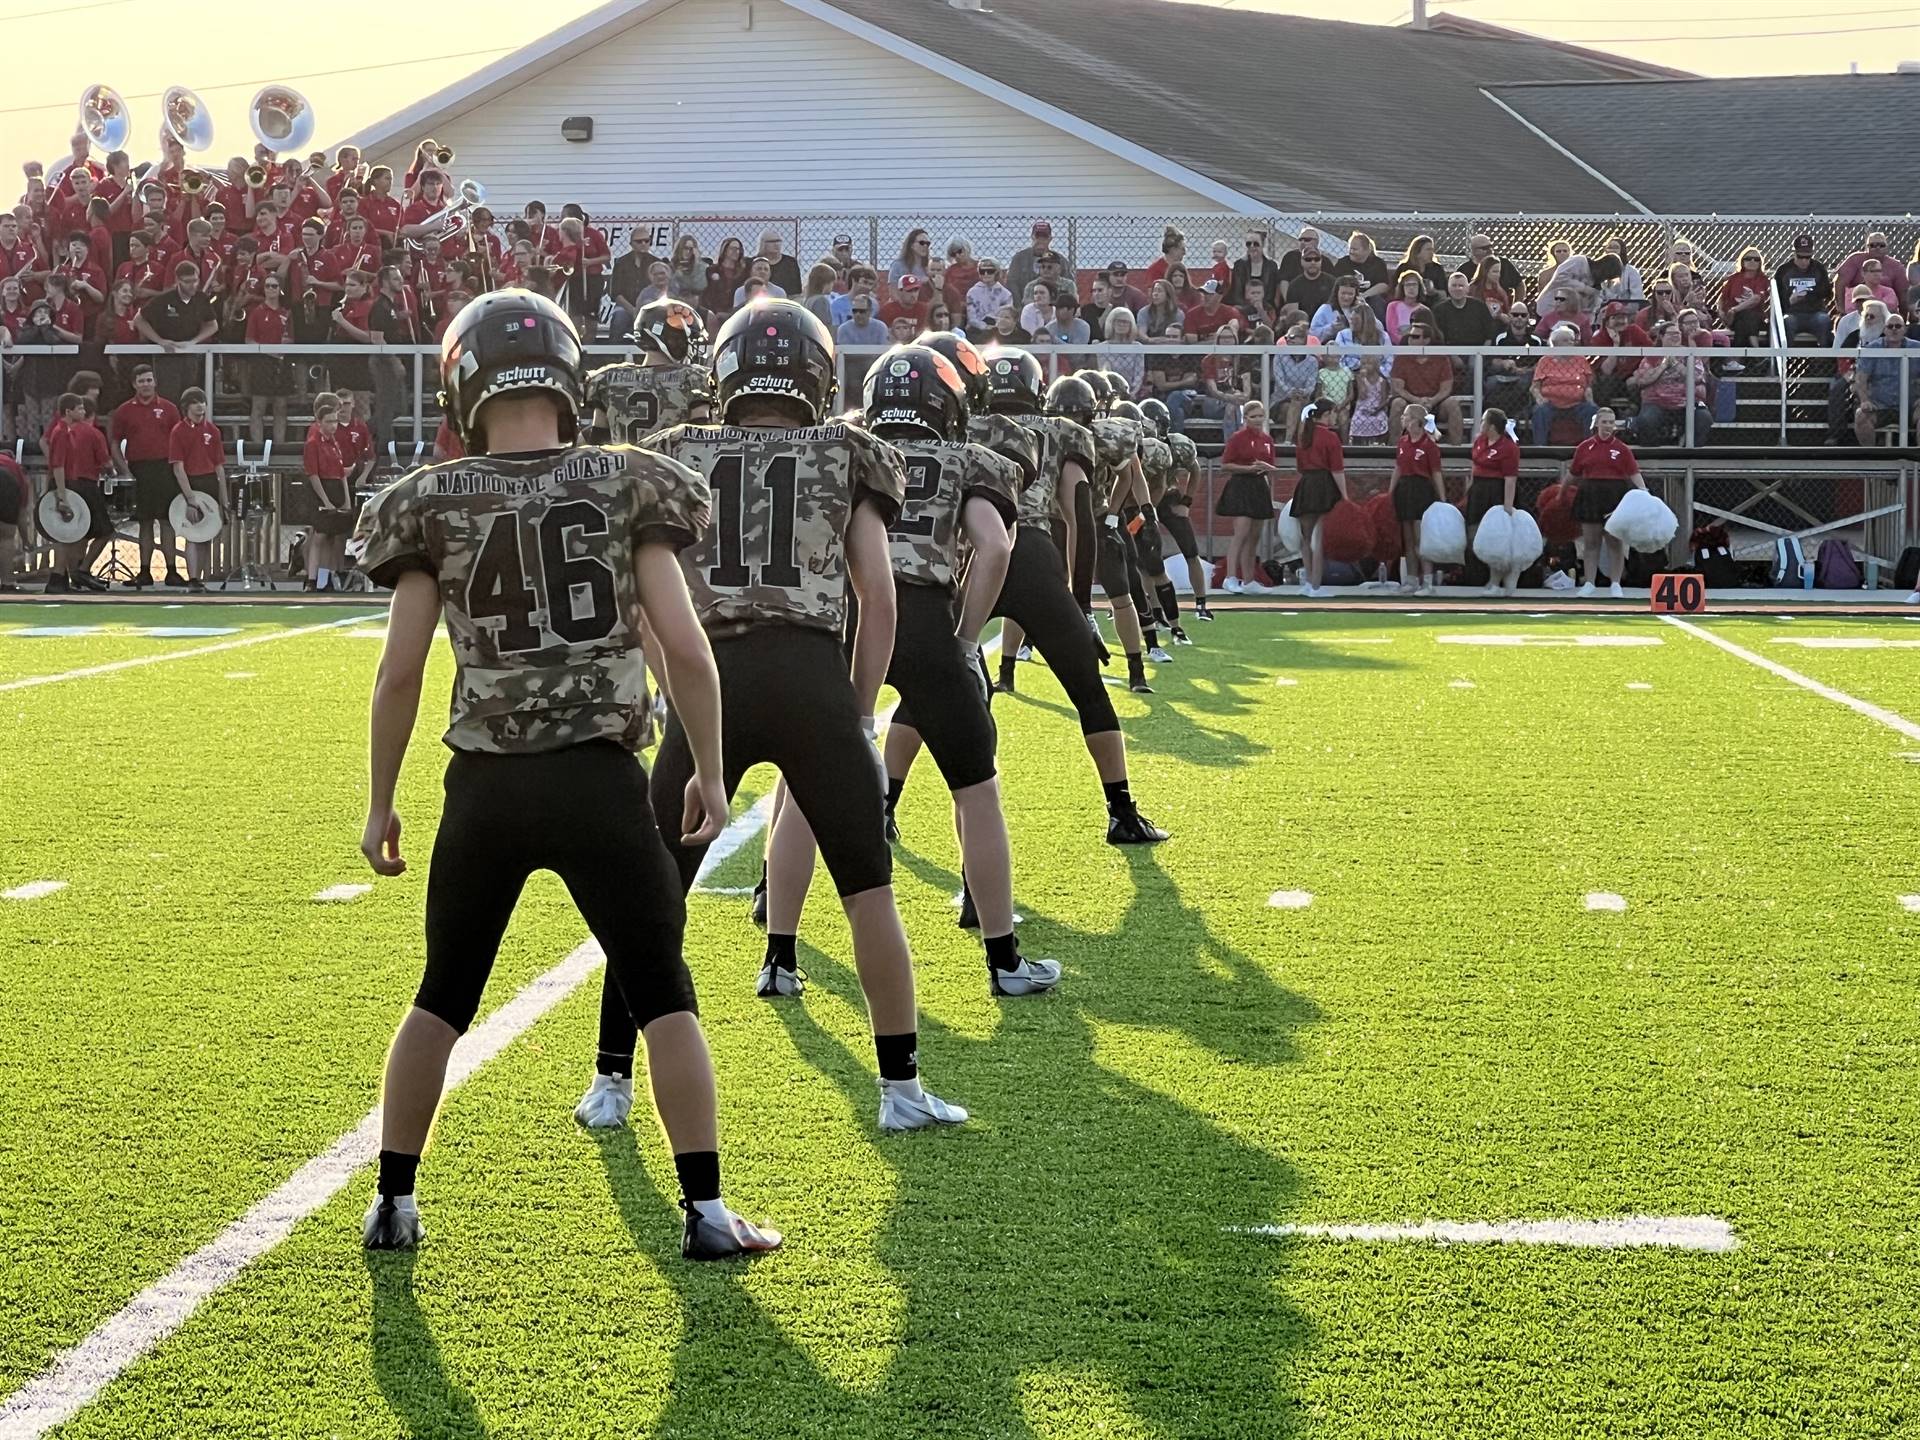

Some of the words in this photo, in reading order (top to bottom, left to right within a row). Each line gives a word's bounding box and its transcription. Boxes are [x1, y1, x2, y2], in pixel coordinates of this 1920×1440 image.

[777, 338, 789, 347] 3.5
[777, 356, 789, 365] 3.5
[749, 375, 794, 389] schutt
[881, 408, 917, 419] schutt
[683, 425, 778, 443] NATIONAL
[784, 424, 845, 441] GUARD
[435, 472, 545, 495] NATIONAL
[552, 454, 627, 484] GUARD
[709, 454, 802, 589] 11
[465, 499, 621, 655] 46
[1655, 576, 1701, 611] 40
